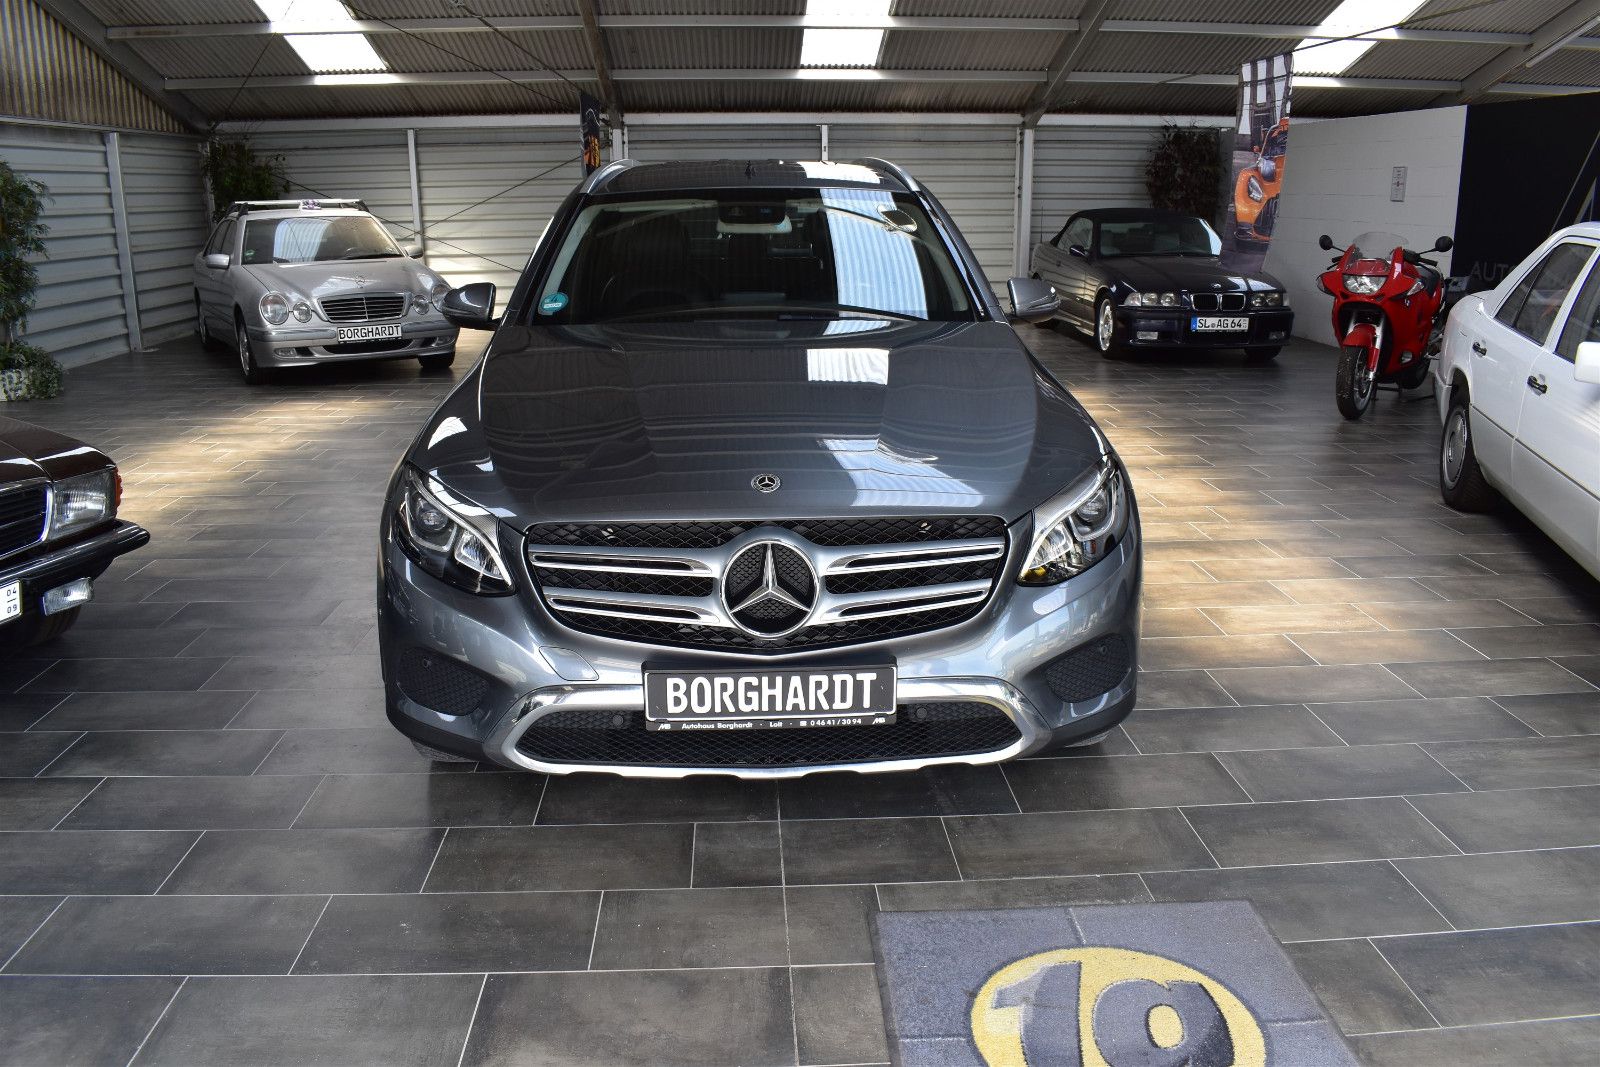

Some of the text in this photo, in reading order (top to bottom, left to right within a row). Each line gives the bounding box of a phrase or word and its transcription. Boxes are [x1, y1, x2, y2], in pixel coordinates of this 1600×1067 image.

[1471, 260, 1517, 281] AUT
[1198, 318, 1210, 329] SL
[1217, 318, 1229, 329] AG
[338, 325, 400, 339] BORGHARDT
[6, 604, 18, 613] 09
[666, 672, 877, 714] BORGHARDT
[682, 722, 715, 730] Autohaus
[717, 721, 753, 730] Borghardt
